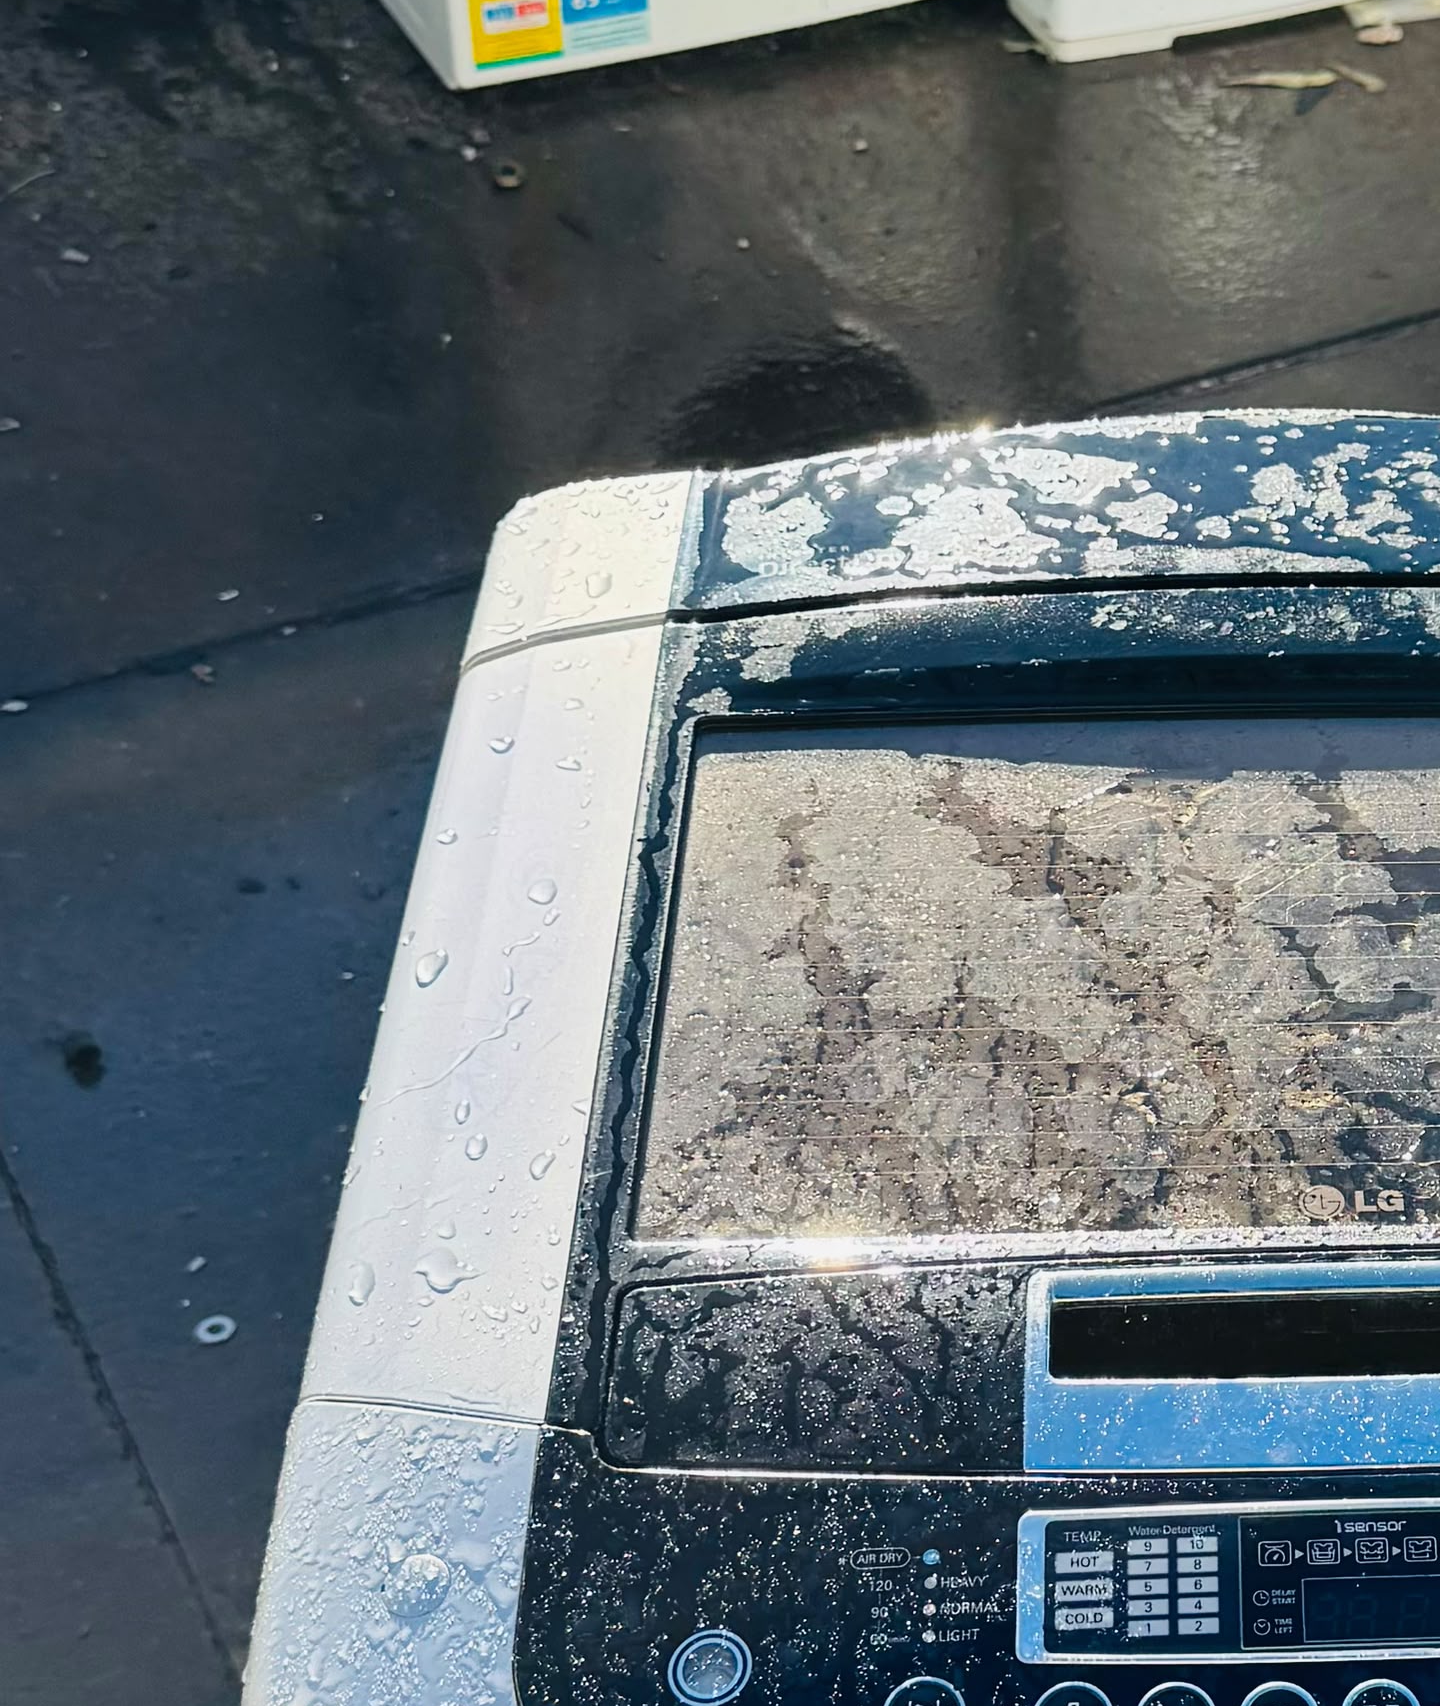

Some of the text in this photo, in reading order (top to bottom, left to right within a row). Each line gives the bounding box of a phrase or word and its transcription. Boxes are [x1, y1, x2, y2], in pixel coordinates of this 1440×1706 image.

[1354, 1189, 1405, 1213] LG
[1144, 1539, 1204, 1552] 9 10
[856, 1552, 904, 1564] AIR DRY
[1070, 1556, 1100, 1568] HOT
[1144, 1559, 1202, 1572] 7 8
[869, 1580, 892, 1591] 120
[1144, 1579, 1202, 1592] 5 6
[1144, 1600, 1202, 1613] 3 4
[1065, 1612, 1103, 1625] COLD
[1195, 1621, 1203, 1632] 2
[939, 1628, 980, 1642] LIGHT
